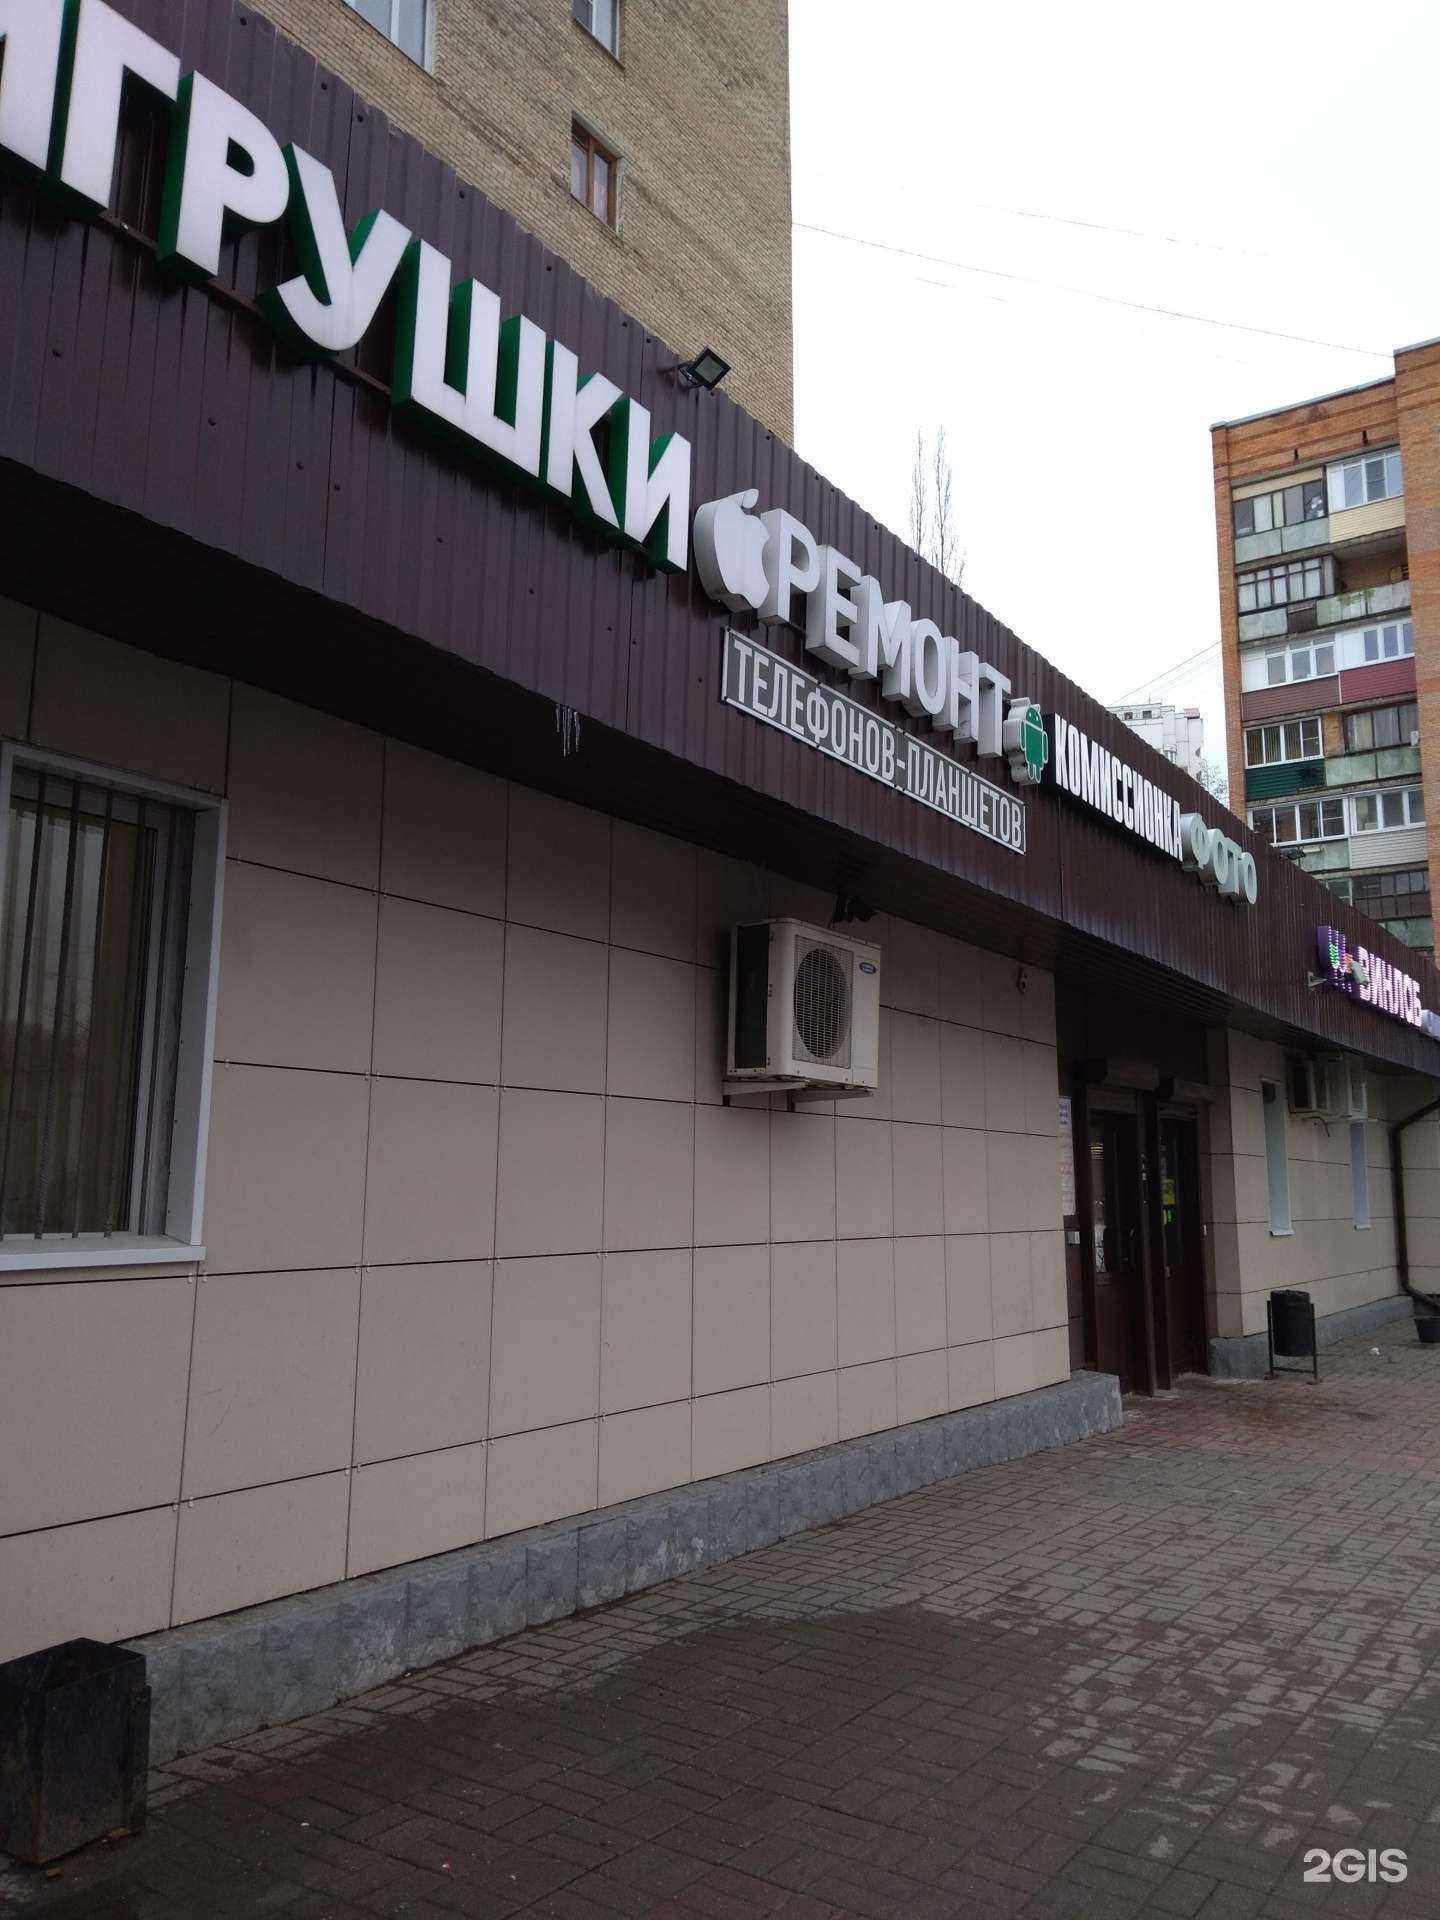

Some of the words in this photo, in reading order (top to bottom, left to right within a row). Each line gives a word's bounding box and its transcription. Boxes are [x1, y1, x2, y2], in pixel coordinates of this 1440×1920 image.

[760, 508, 1011, 758] РЕМОНТ
[1054, 712, 1184, 863] КОМИССИОНКА
[1186, 812, 1258, 905] ФОТО
